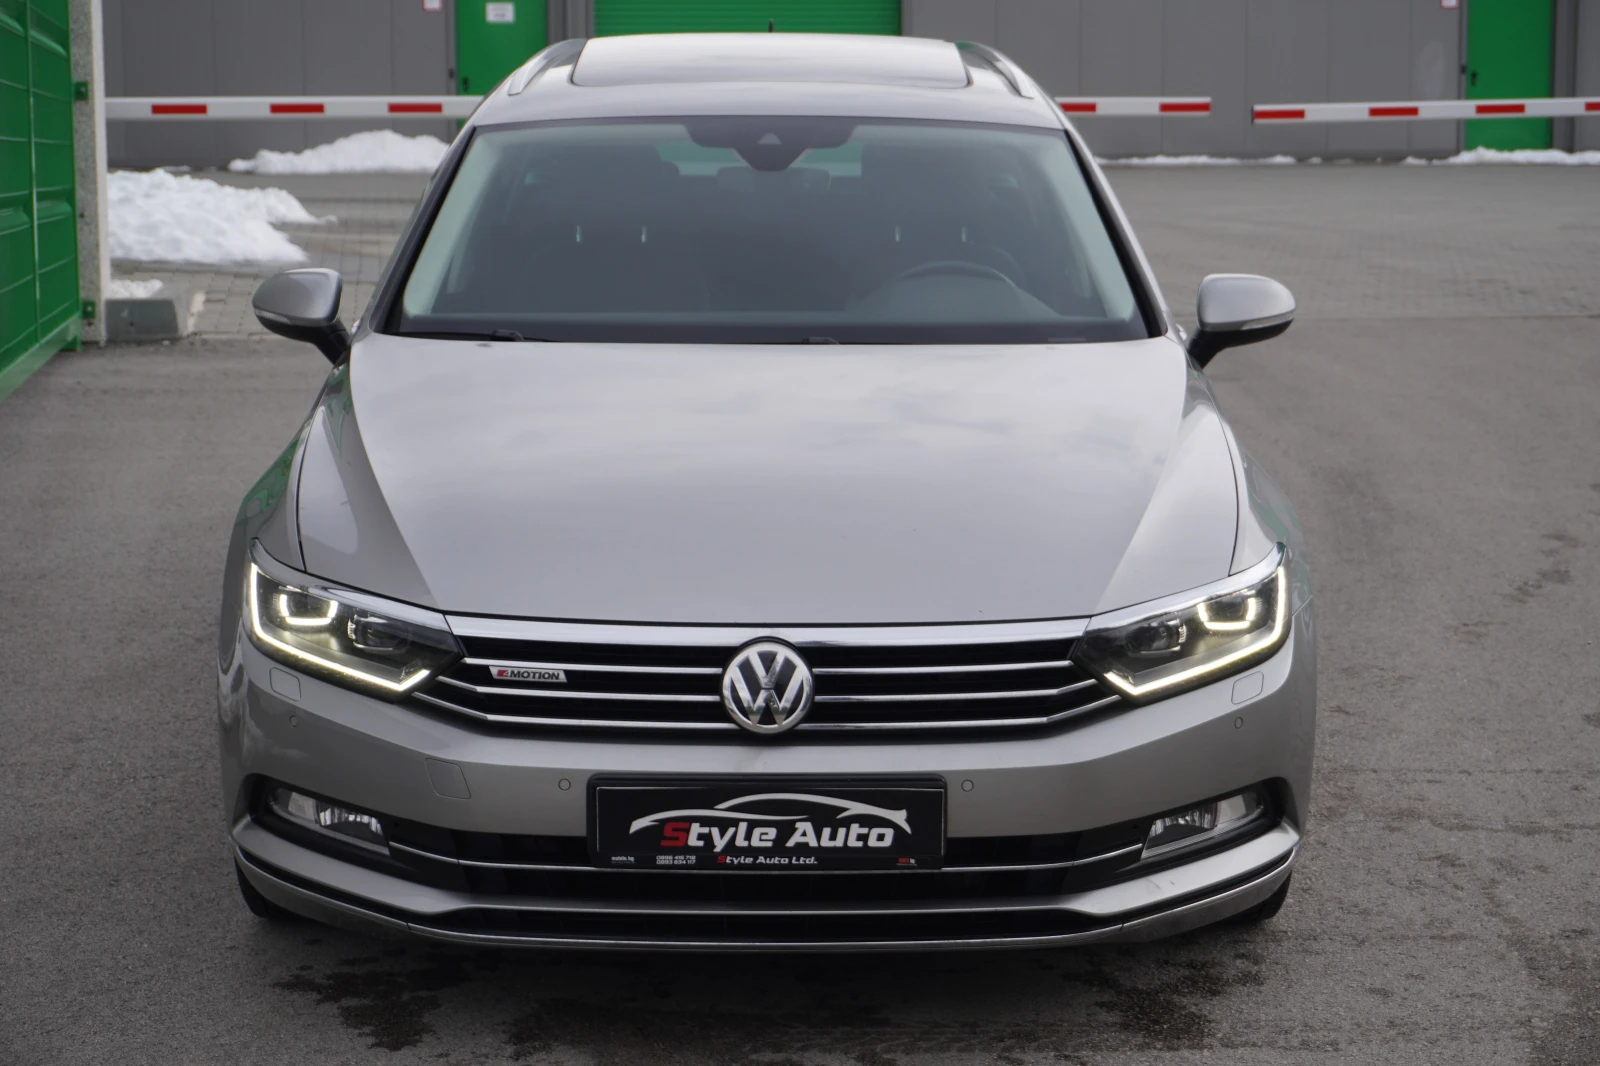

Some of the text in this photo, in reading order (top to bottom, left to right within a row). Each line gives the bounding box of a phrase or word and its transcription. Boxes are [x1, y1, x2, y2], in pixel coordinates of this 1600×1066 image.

[660, 821, 895, 852] Style Auto
[717, 856, 818, 865] Style Auto Ltd.
